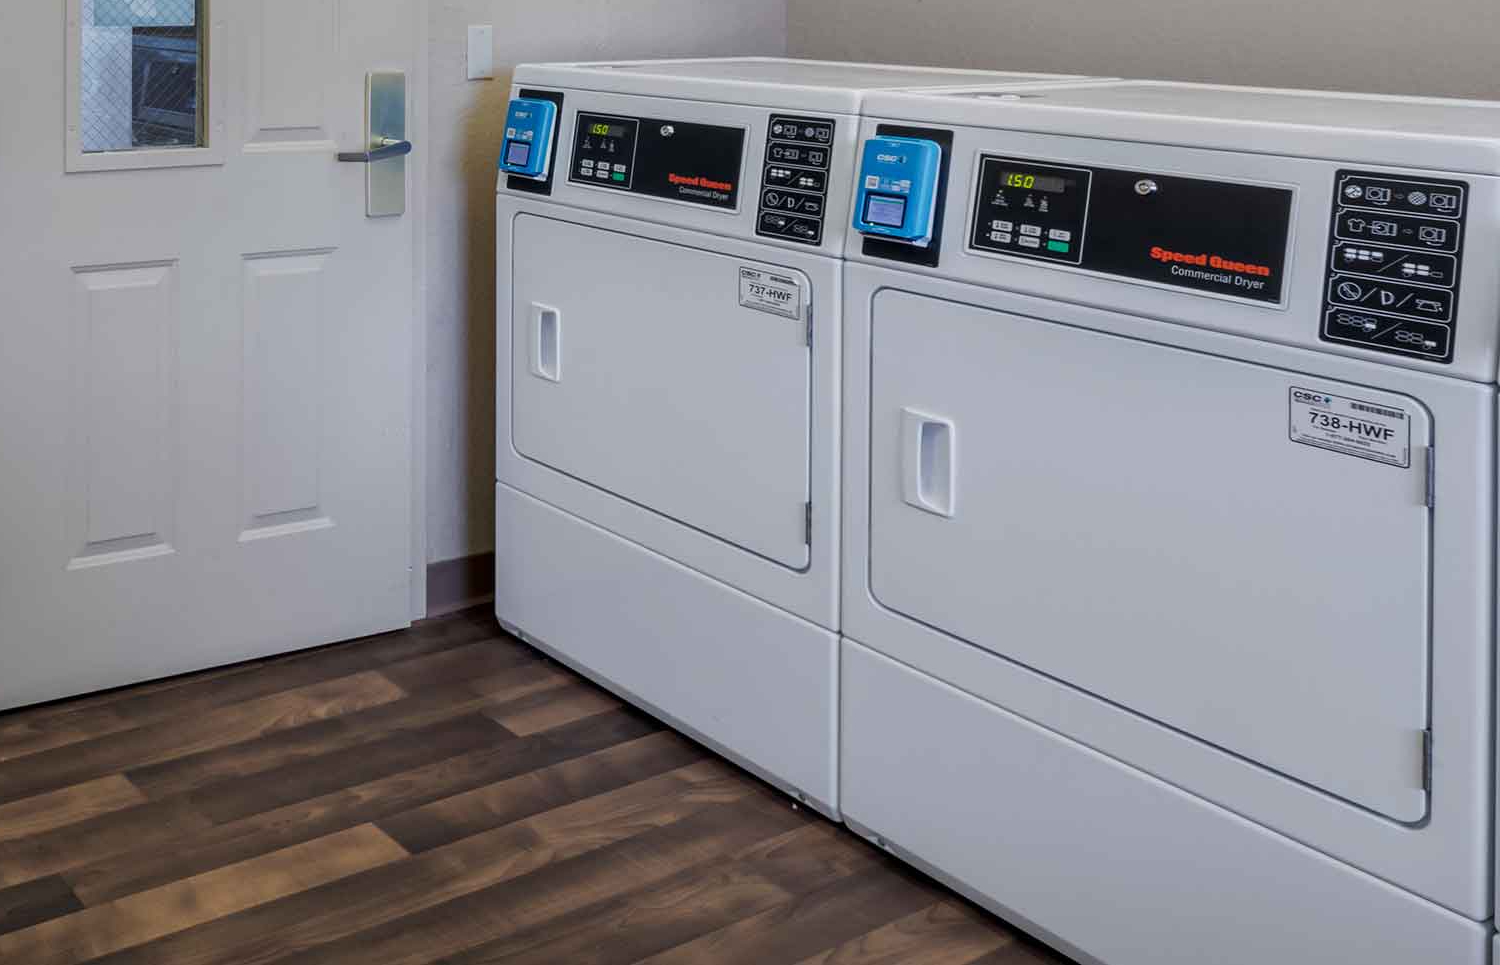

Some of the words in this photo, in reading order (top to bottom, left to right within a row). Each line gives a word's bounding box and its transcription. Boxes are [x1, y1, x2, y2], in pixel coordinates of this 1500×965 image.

[1149, 246, 1207, 266] Speed
[1209, 256, 1270, 277] Queen
[1171, 265, 1232, 284] Commercial
[1234, 276, 1265, 290] Dryer
[749, 284, 793, 301] 737-HWF
[1293, 391, 1322, 402] CSC
[1308, 412, 1395, 440] 738-HWF
